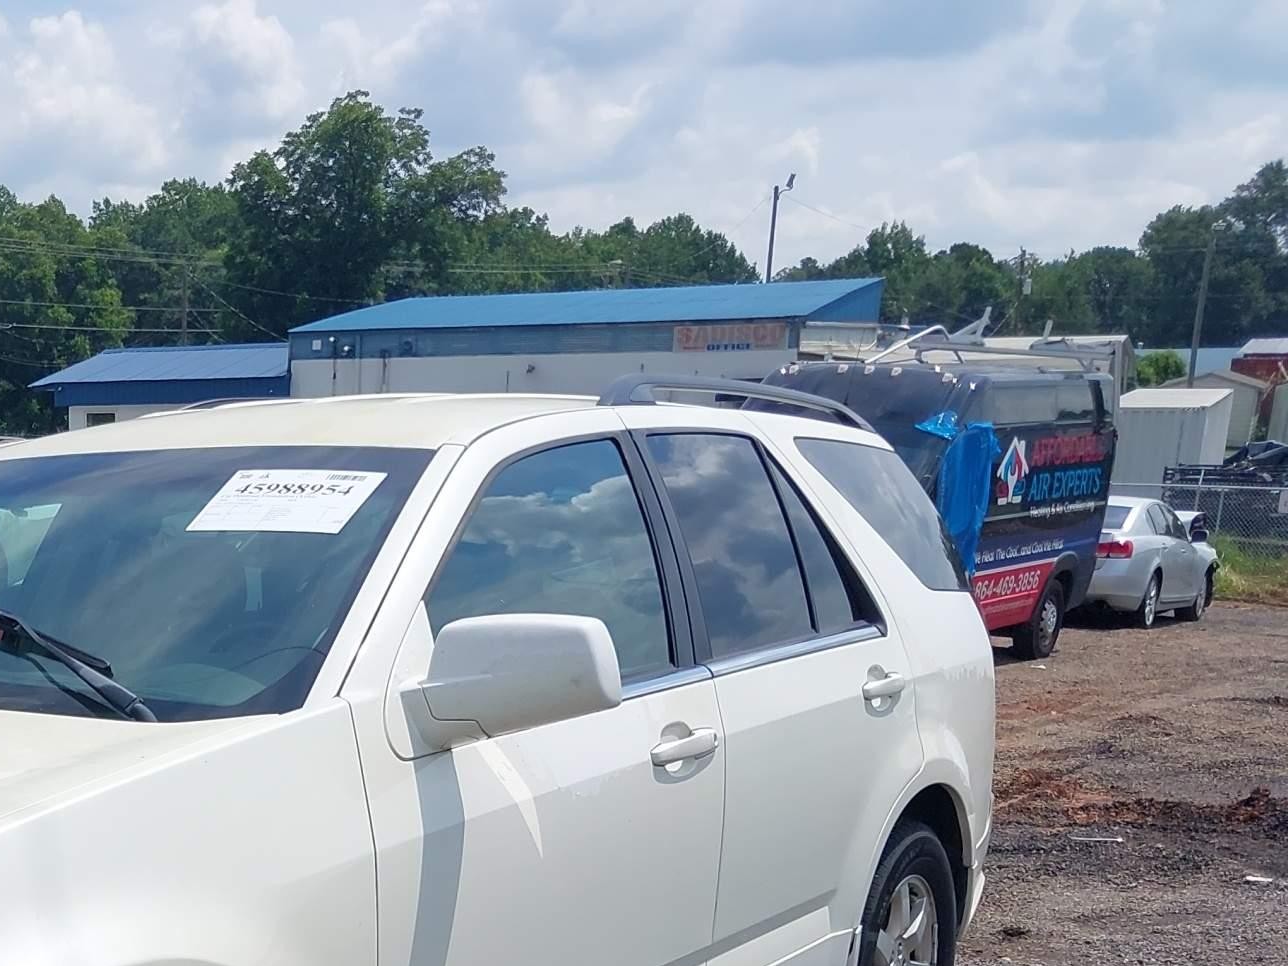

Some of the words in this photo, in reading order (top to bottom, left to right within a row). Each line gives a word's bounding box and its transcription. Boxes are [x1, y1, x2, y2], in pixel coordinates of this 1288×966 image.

[234, 482, 356, 496] 45988954
[1027, 472, 1051, 501] AIR
[1051, 467, 1102, 499] EXPERTS
[974, 570, 1041, 599] 864-469-3856
